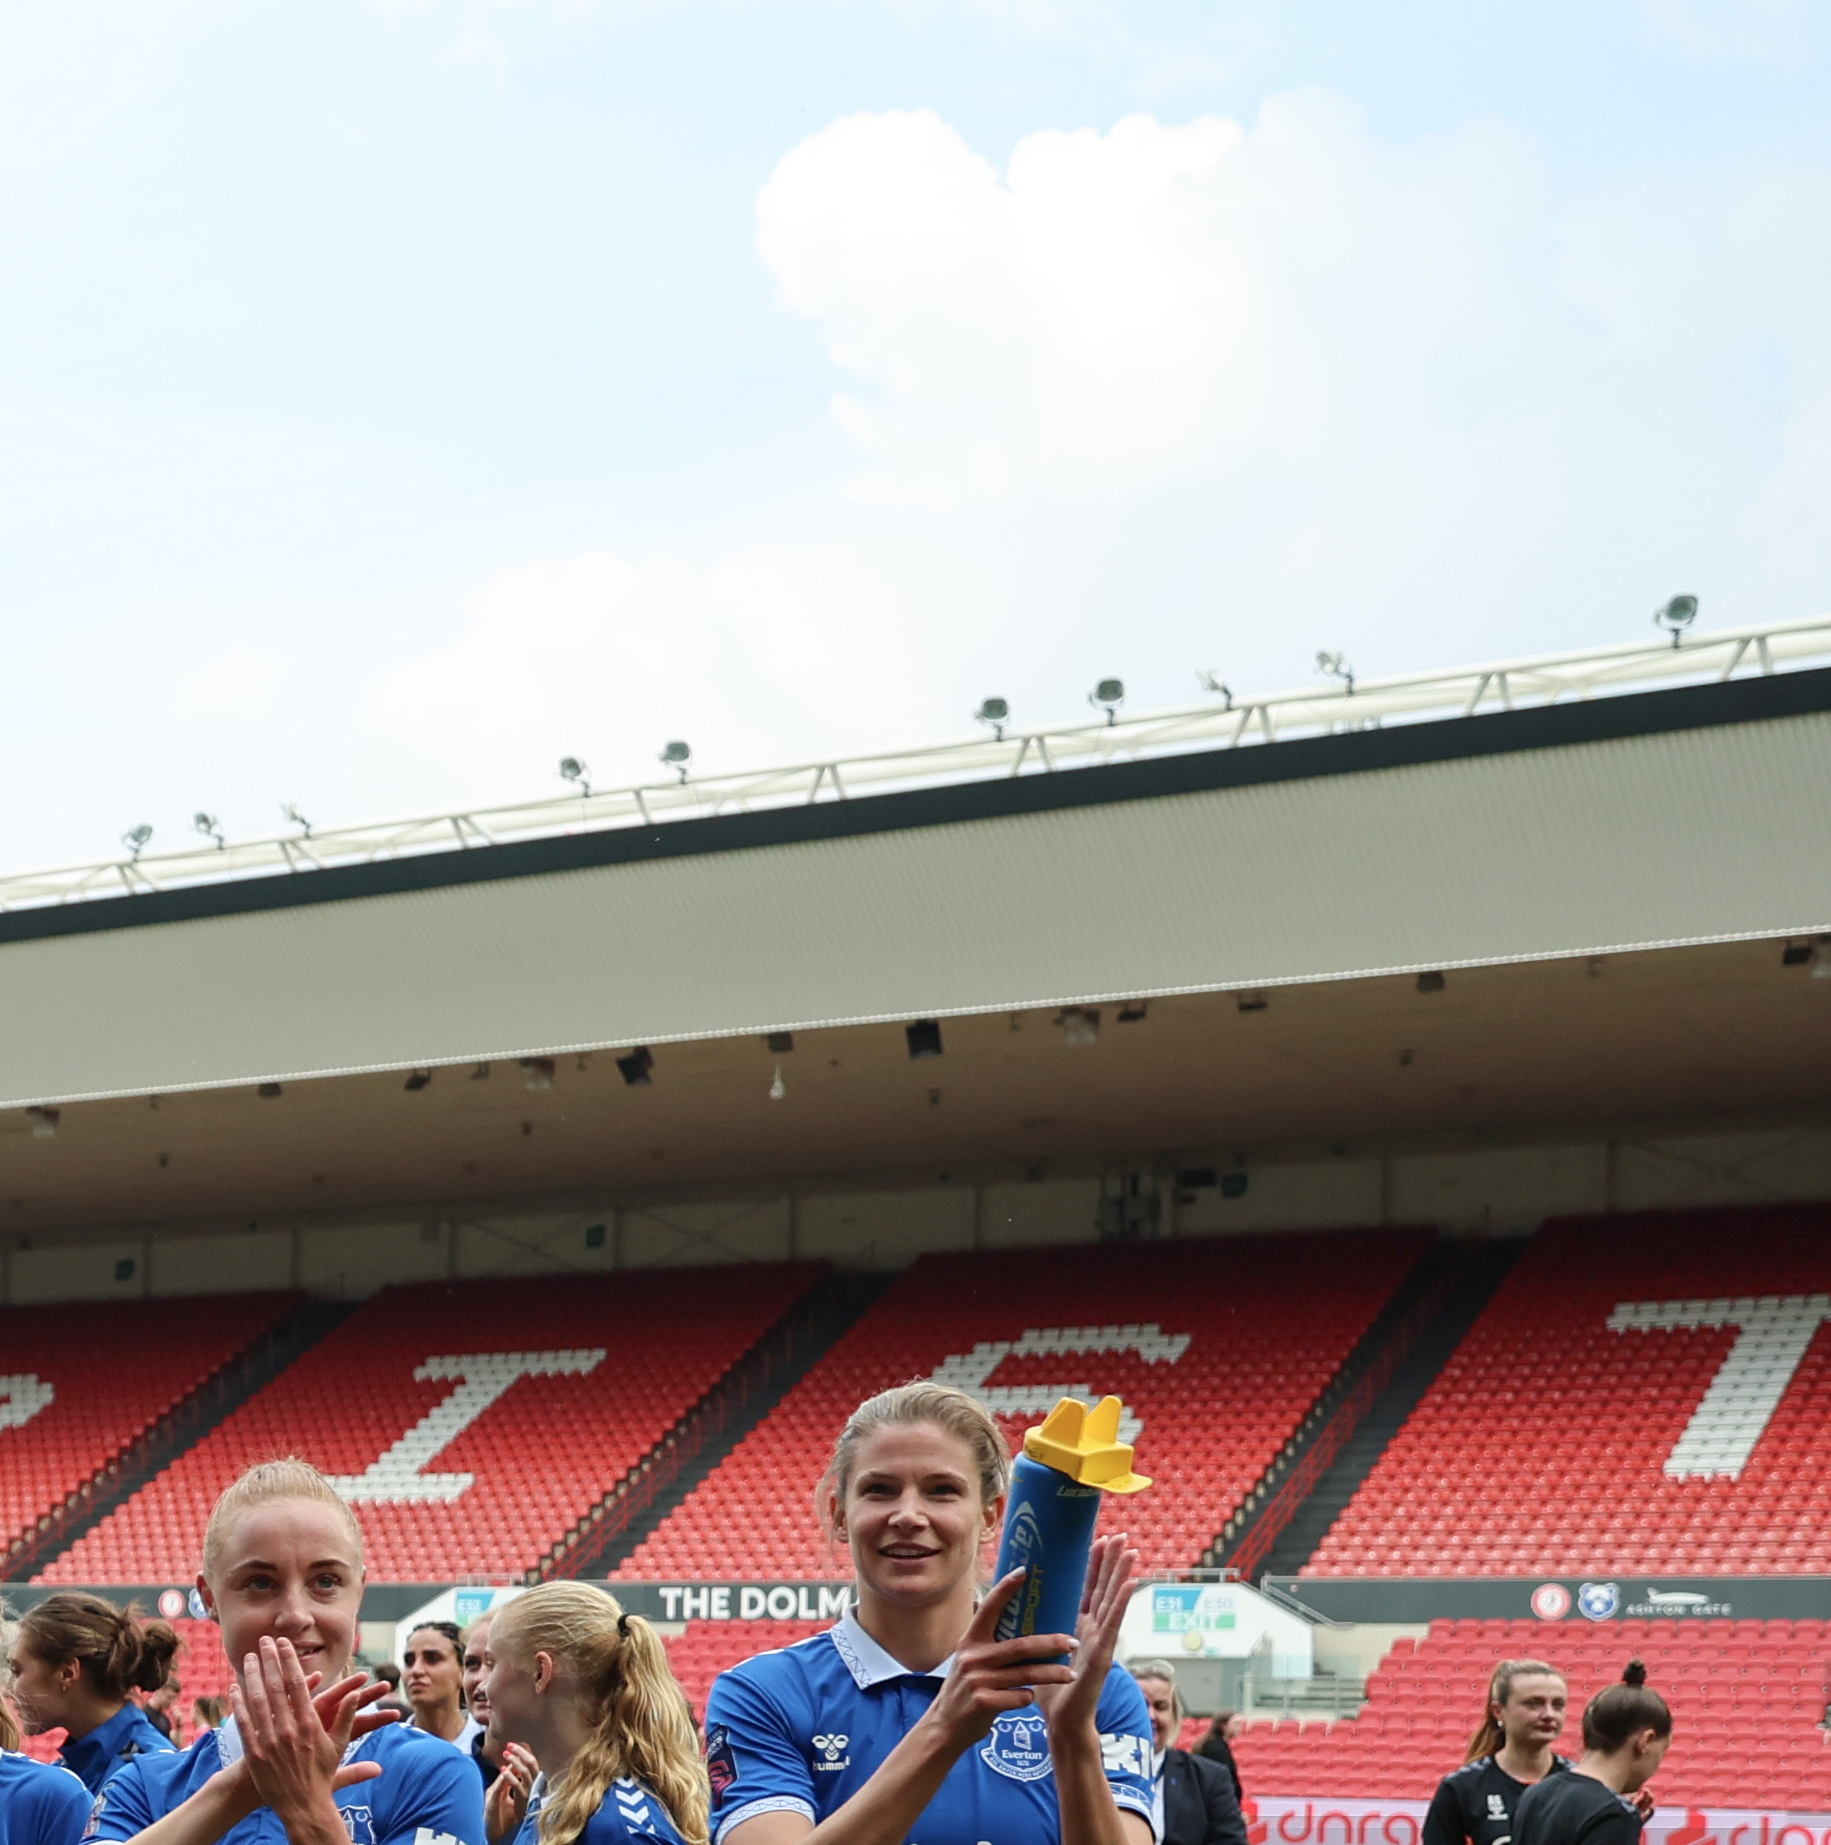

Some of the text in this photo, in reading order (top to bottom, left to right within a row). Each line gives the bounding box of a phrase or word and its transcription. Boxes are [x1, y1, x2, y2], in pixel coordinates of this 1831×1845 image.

[659, 1586, 851, 1620] THE DOLM
[1021, 1564, 1045, 1635] SPORT
[813, 1757, 850, 1772] humml
[1002, 1750, 1042, 1761] Everton
[1101, 1733, 1151, 1780] KI
